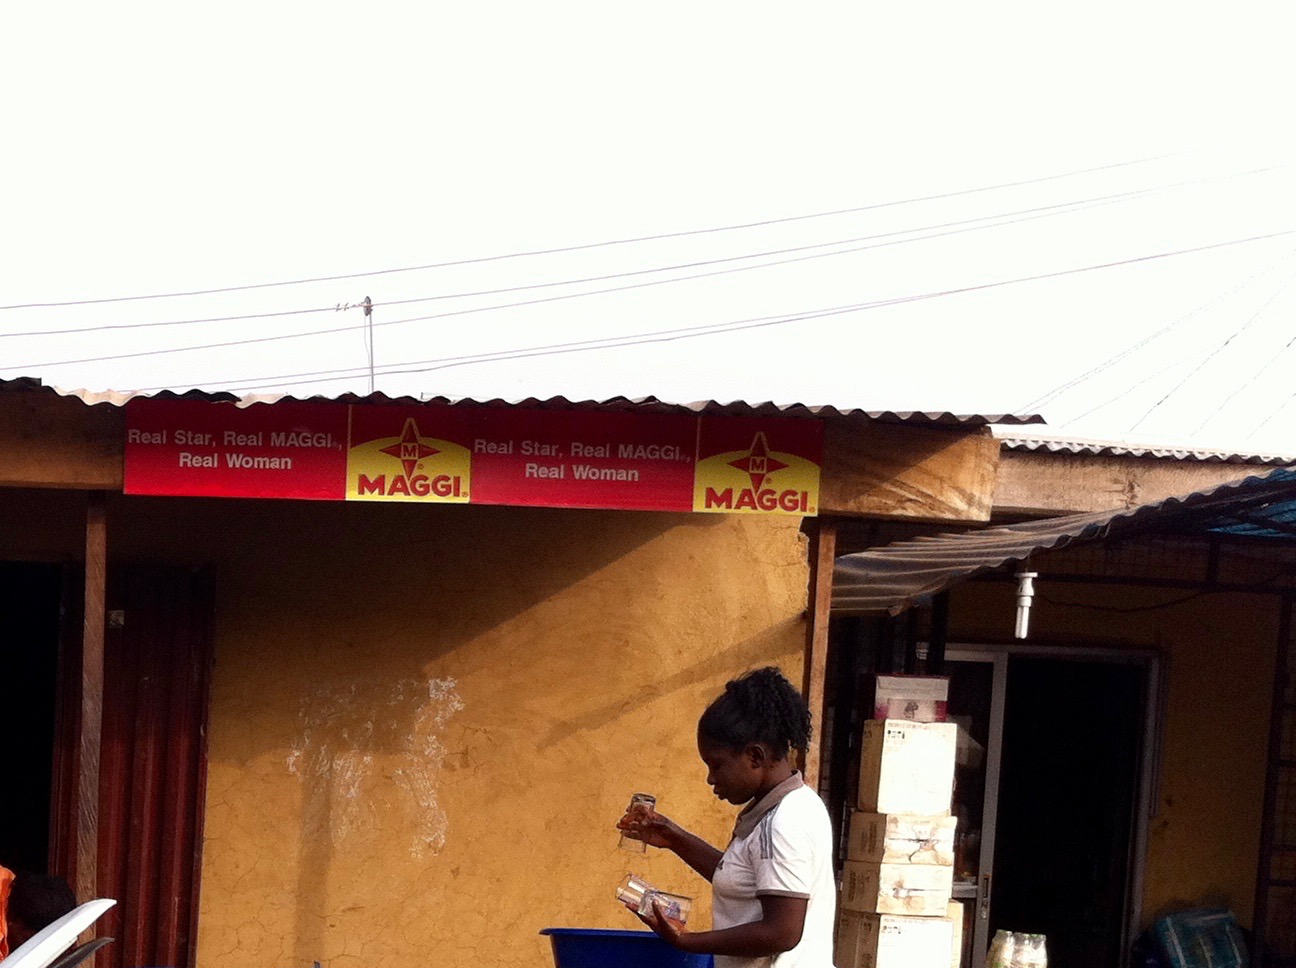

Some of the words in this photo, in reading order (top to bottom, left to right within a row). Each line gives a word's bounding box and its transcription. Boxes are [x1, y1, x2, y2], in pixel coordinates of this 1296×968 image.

[128, 429, 167, 445] Real
[174, 430, 216, 447] Star,
[223, 431, 263, 446] Real
[474, 439, 513, 454] Real
[521, 440, 563, 458] Star,
[571, 442, 610, 457] Real
[179, 452, 218, 468] Real
[226, 453, 292, 470] Woman
[525, 463, 564, 479] Real
[572, 464, 639, 482] Woman
[357, 474, 461, 498] MAGGI
[705, 487, 809, 513] MAGGI
